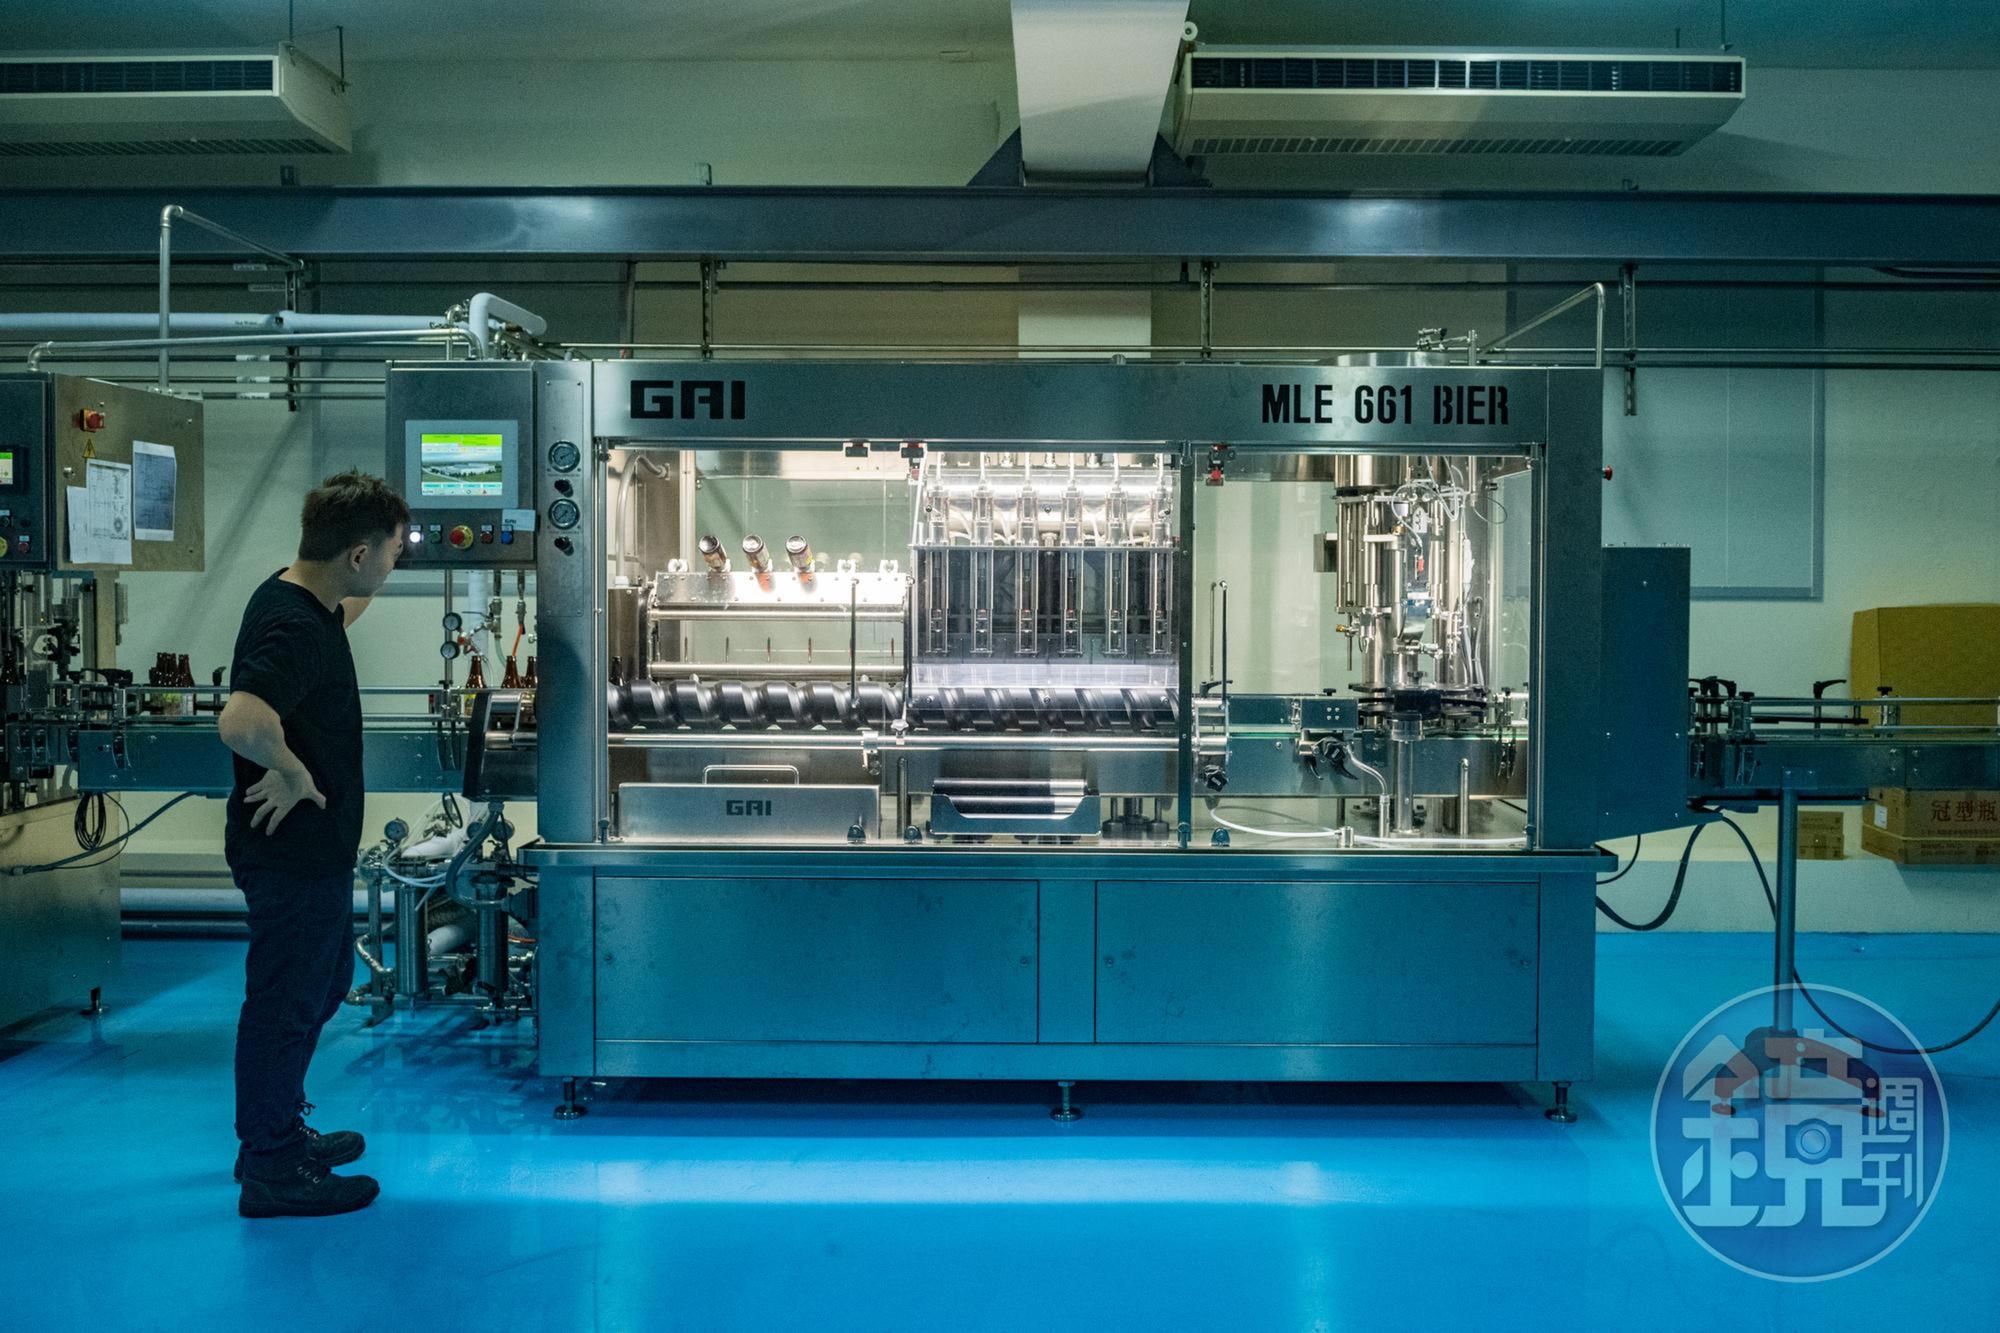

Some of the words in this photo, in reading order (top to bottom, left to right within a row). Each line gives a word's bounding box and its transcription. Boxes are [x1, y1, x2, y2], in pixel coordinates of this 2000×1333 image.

[630, 380, 746, 420] GAI
[1262, 384, 1333, 424] MLE
[1354, 384, 1412, 424] 661
[1433, 385, 1509, 425] BIER
[726, 800, 772, 816] GAI
[1930, 799, 1998, 822] 冠型瓶
